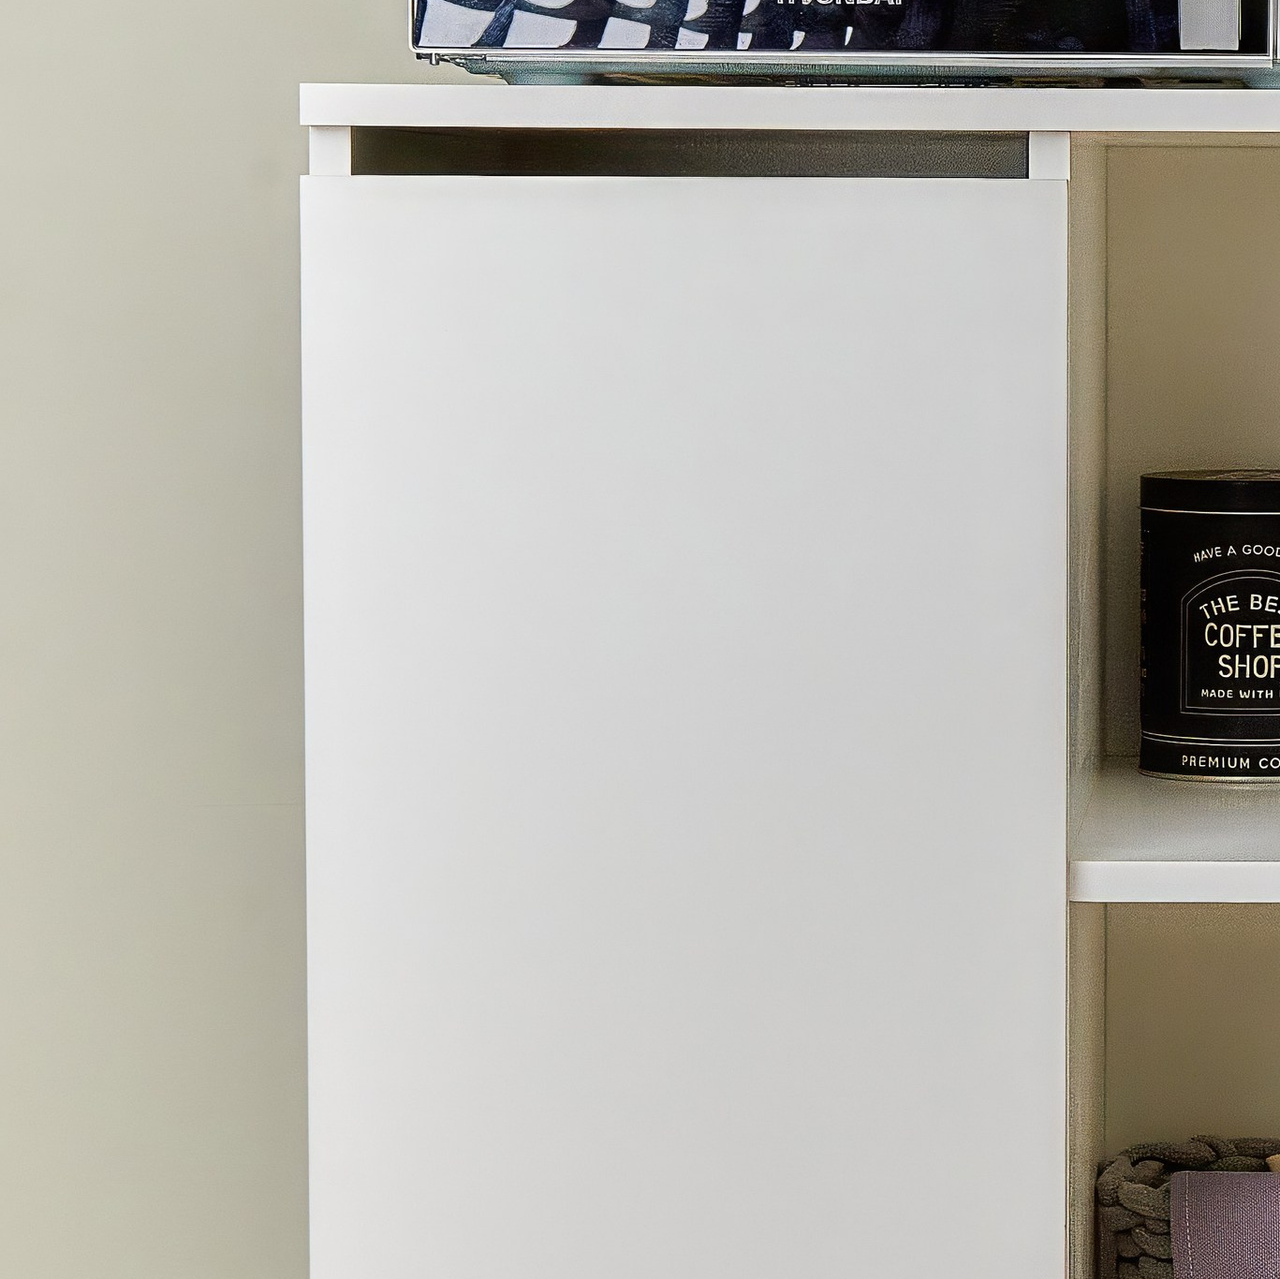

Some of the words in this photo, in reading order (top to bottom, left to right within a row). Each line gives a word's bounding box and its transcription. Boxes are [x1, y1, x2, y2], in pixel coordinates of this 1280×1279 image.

[1193, 546, 1222, 563] HAVE
[1226, 545, 1237, 557] A
[1199, 594, 1240, 620] THE
[1200, 688, 1234, 699] MADE
[1238, 689, 1274, 699] WITH
[1181, 754, 1250, 770] PREMIUM
